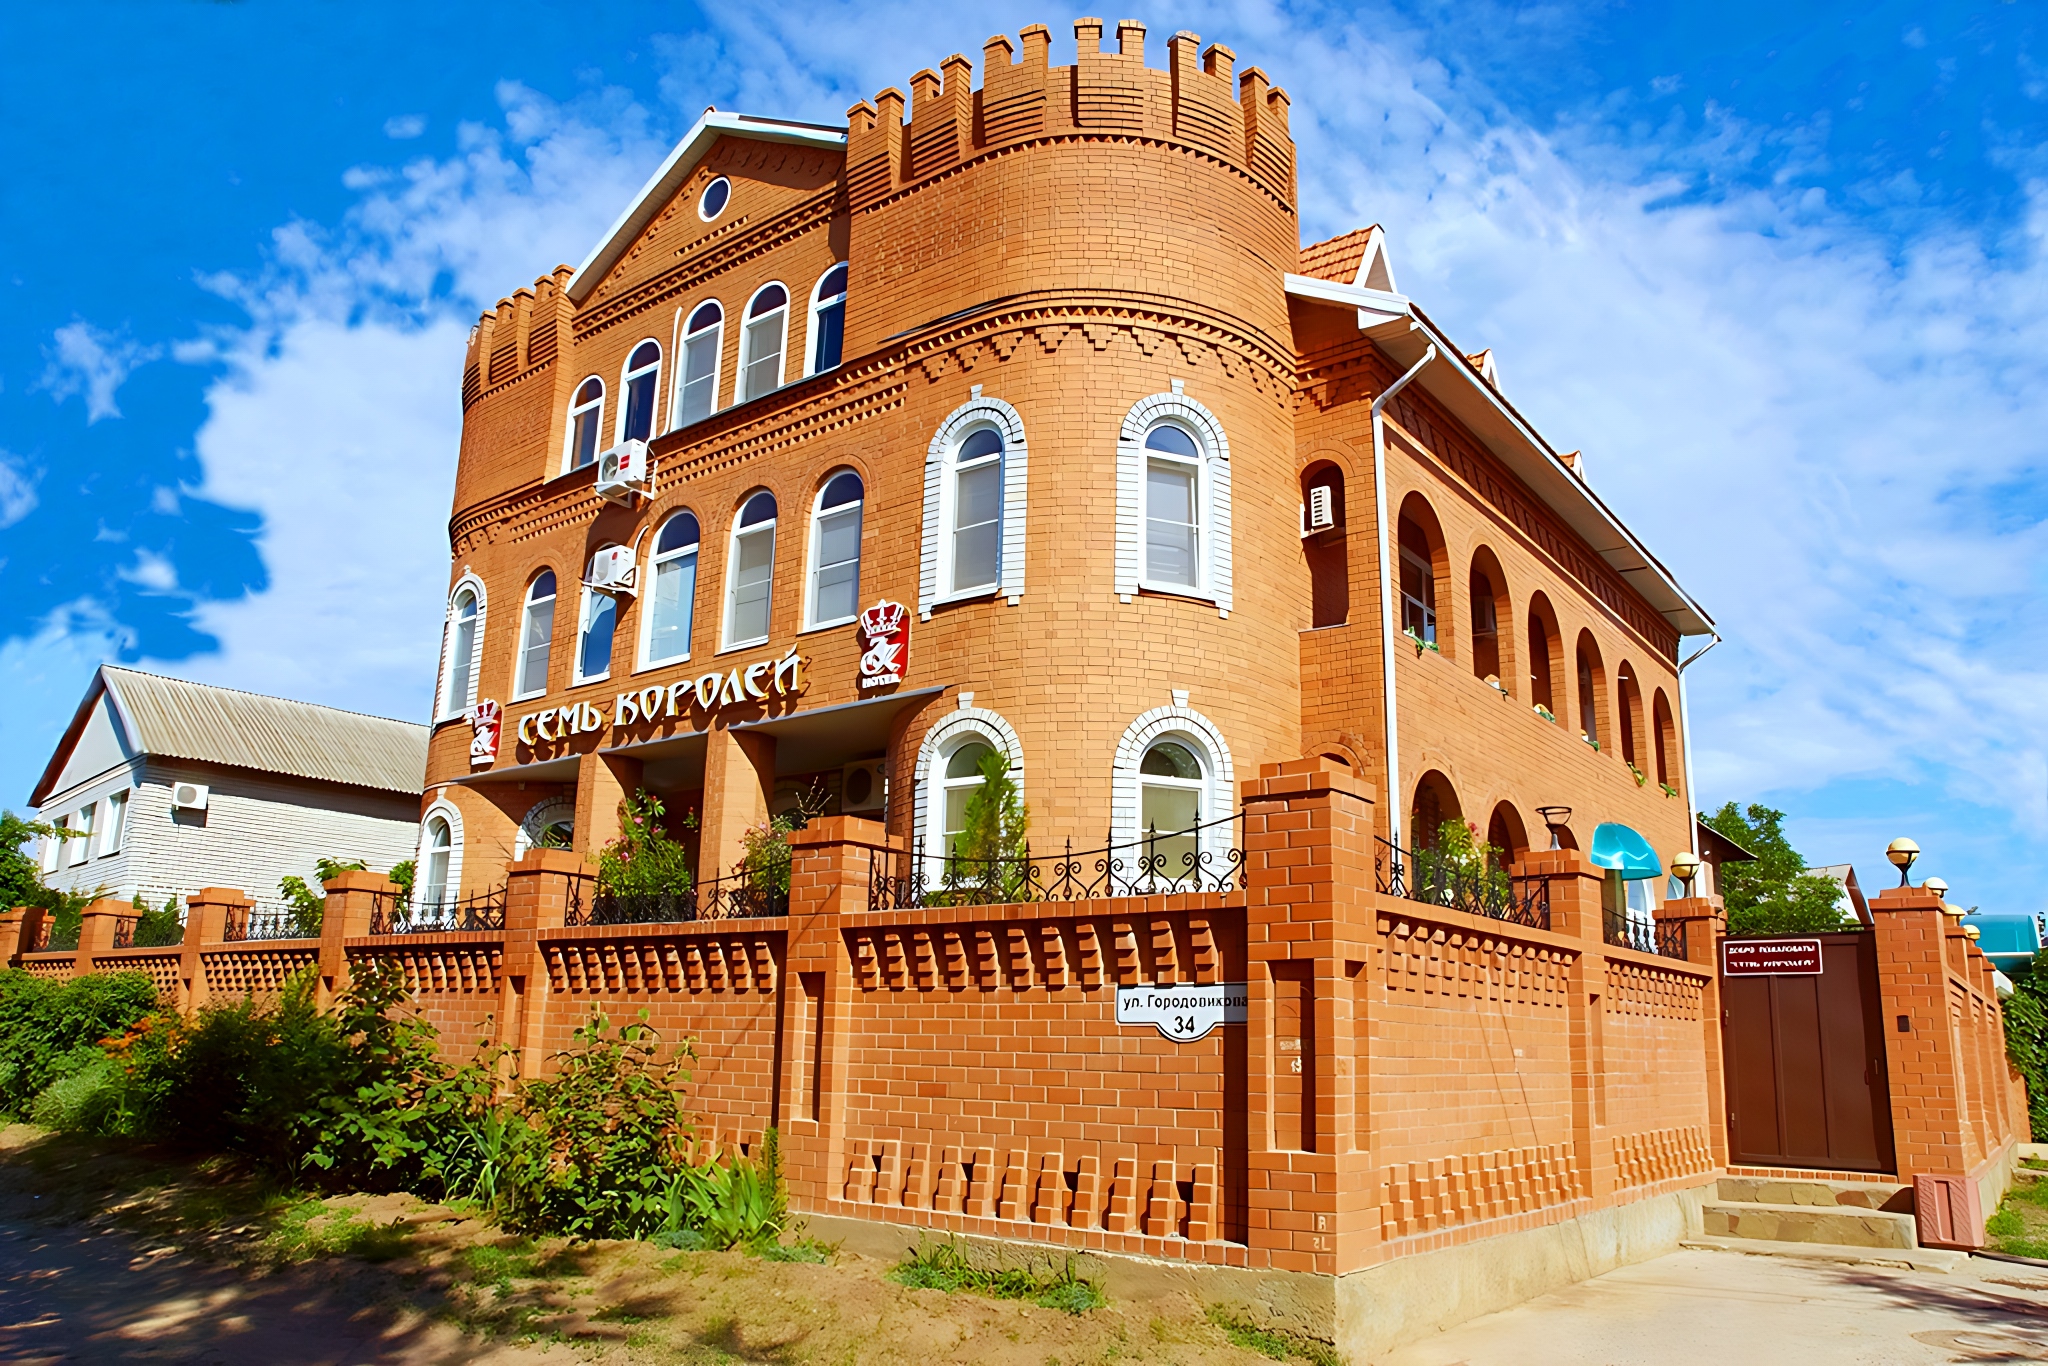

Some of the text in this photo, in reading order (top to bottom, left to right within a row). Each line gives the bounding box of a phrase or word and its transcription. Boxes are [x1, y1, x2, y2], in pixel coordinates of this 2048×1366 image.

[518, 643, 800, 746] СЕМЬ КОРОЛЕЙ
[1123, 997, 1144, 1011] ул.
[1173, 1015, 1196, 1034] 34
